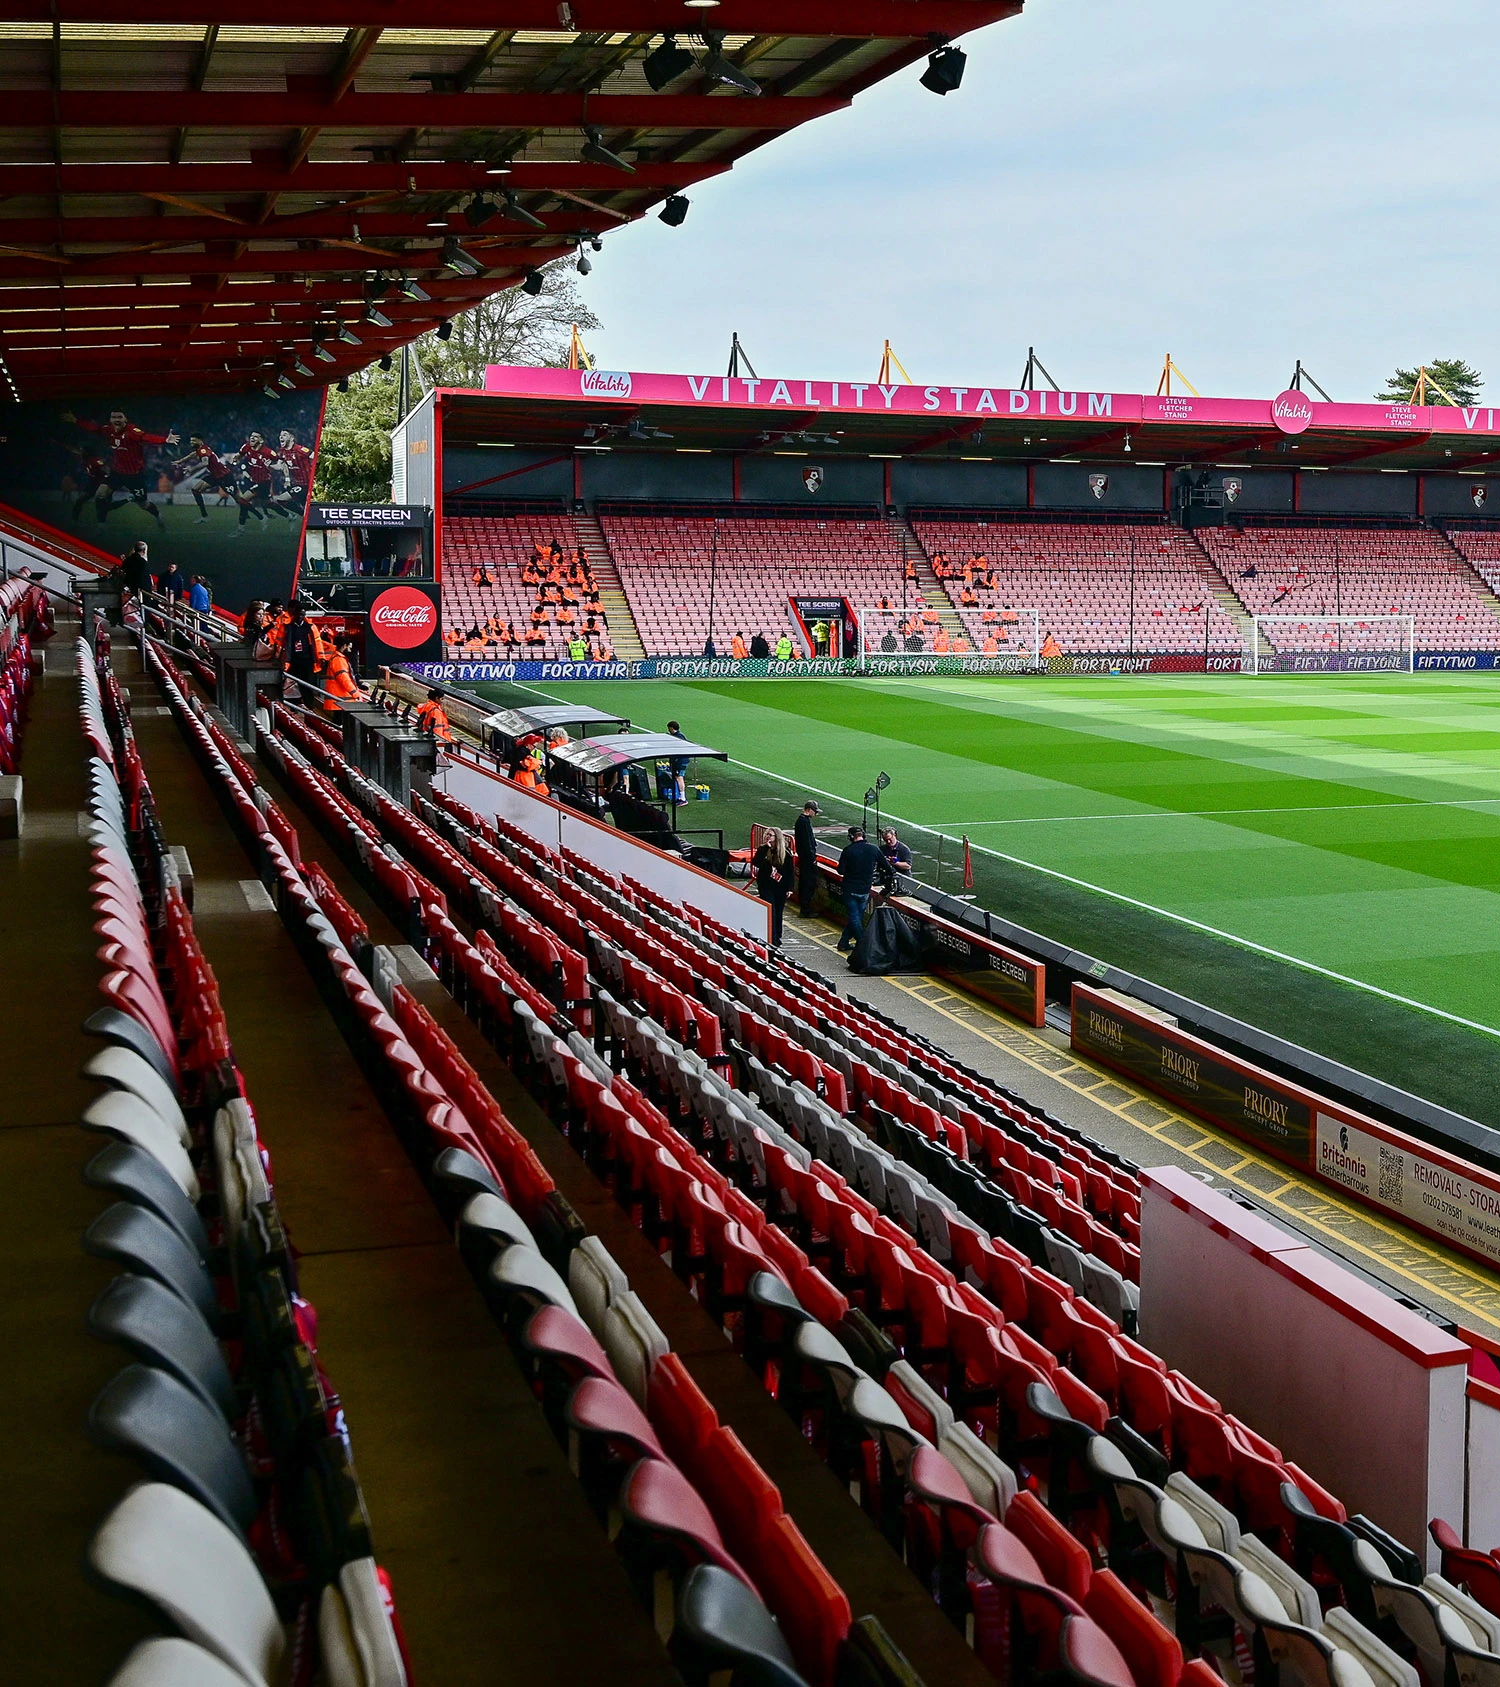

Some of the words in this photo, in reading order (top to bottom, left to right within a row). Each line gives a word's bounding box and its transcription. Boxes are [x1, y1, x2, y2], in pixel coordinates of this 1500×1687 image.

[583, 371, 630, 397] Vitality
[687, 376, 899, 409] VITALITY
[924, 387, 1112, 418] STADIUM
[1274, 399, 1312, 423] Vitality
[1392, 406, 1411, 414] STEVE
[319, 508, 348, 519] TEE
[352, 509, 411, 520] SCREEN
[375, 605, 433, 624] Coca-Cola
[424, 664, 516, 679] FORTYTWO
[542, 662, 642, 678] FORTYTHREE
[656, 661, 742, 675] FORTYFOUR
[767, 660, 846, 674] FORTYFIVE
[871, 659, 938, 674] FORTYSIX
[1072, 658, 1153, 672] FORTYEIGHT
[1294, 657, 1328, 670] FIFTY
[1347, 656, 1402, 669] FIFTYONE
[1418, 656, 1476, 668] FIFTYTWO
[936, 930, 948, 945] TEE
[948, 935, 971, 956] SCREEN
[988, 954, 1001, 970] TEE
[1001, 960, 1027, 983] SCREEN
[566, 1000, 574, 1009] H
[1090, 1010, 1124, 1044] PRIORY
[1161, 1046, 1200, 1082] PRIORY
[1244, 1086, 1288, 1127] PRIORY
[1243, 1110, 1268, 1128] CONCEPT
[1268, 1120, 1288, 1136] GROUP
[1322, 1140, 1366, 1178] Britannia
[1318, 1158, 1370, 1195] Leatherbarrows
[1414, 1162, 1462, 1200] REMOVALS
[1298, 1204, 1357, 1226] NO
[1422, 1192, 1441, 1210] 01202
[1442, 1200, 1462, 1221] 578581
[1436, 1218, 1448, 1230] scan
[1448, 1222, 1457, 1234] the
[1457, 1227, 1466, 1240] QR
[1466, 1232, 1478, 1244] code
[1478, 1236, 1486, 1248] for
[1486, 1243, 1498, 1256] your
